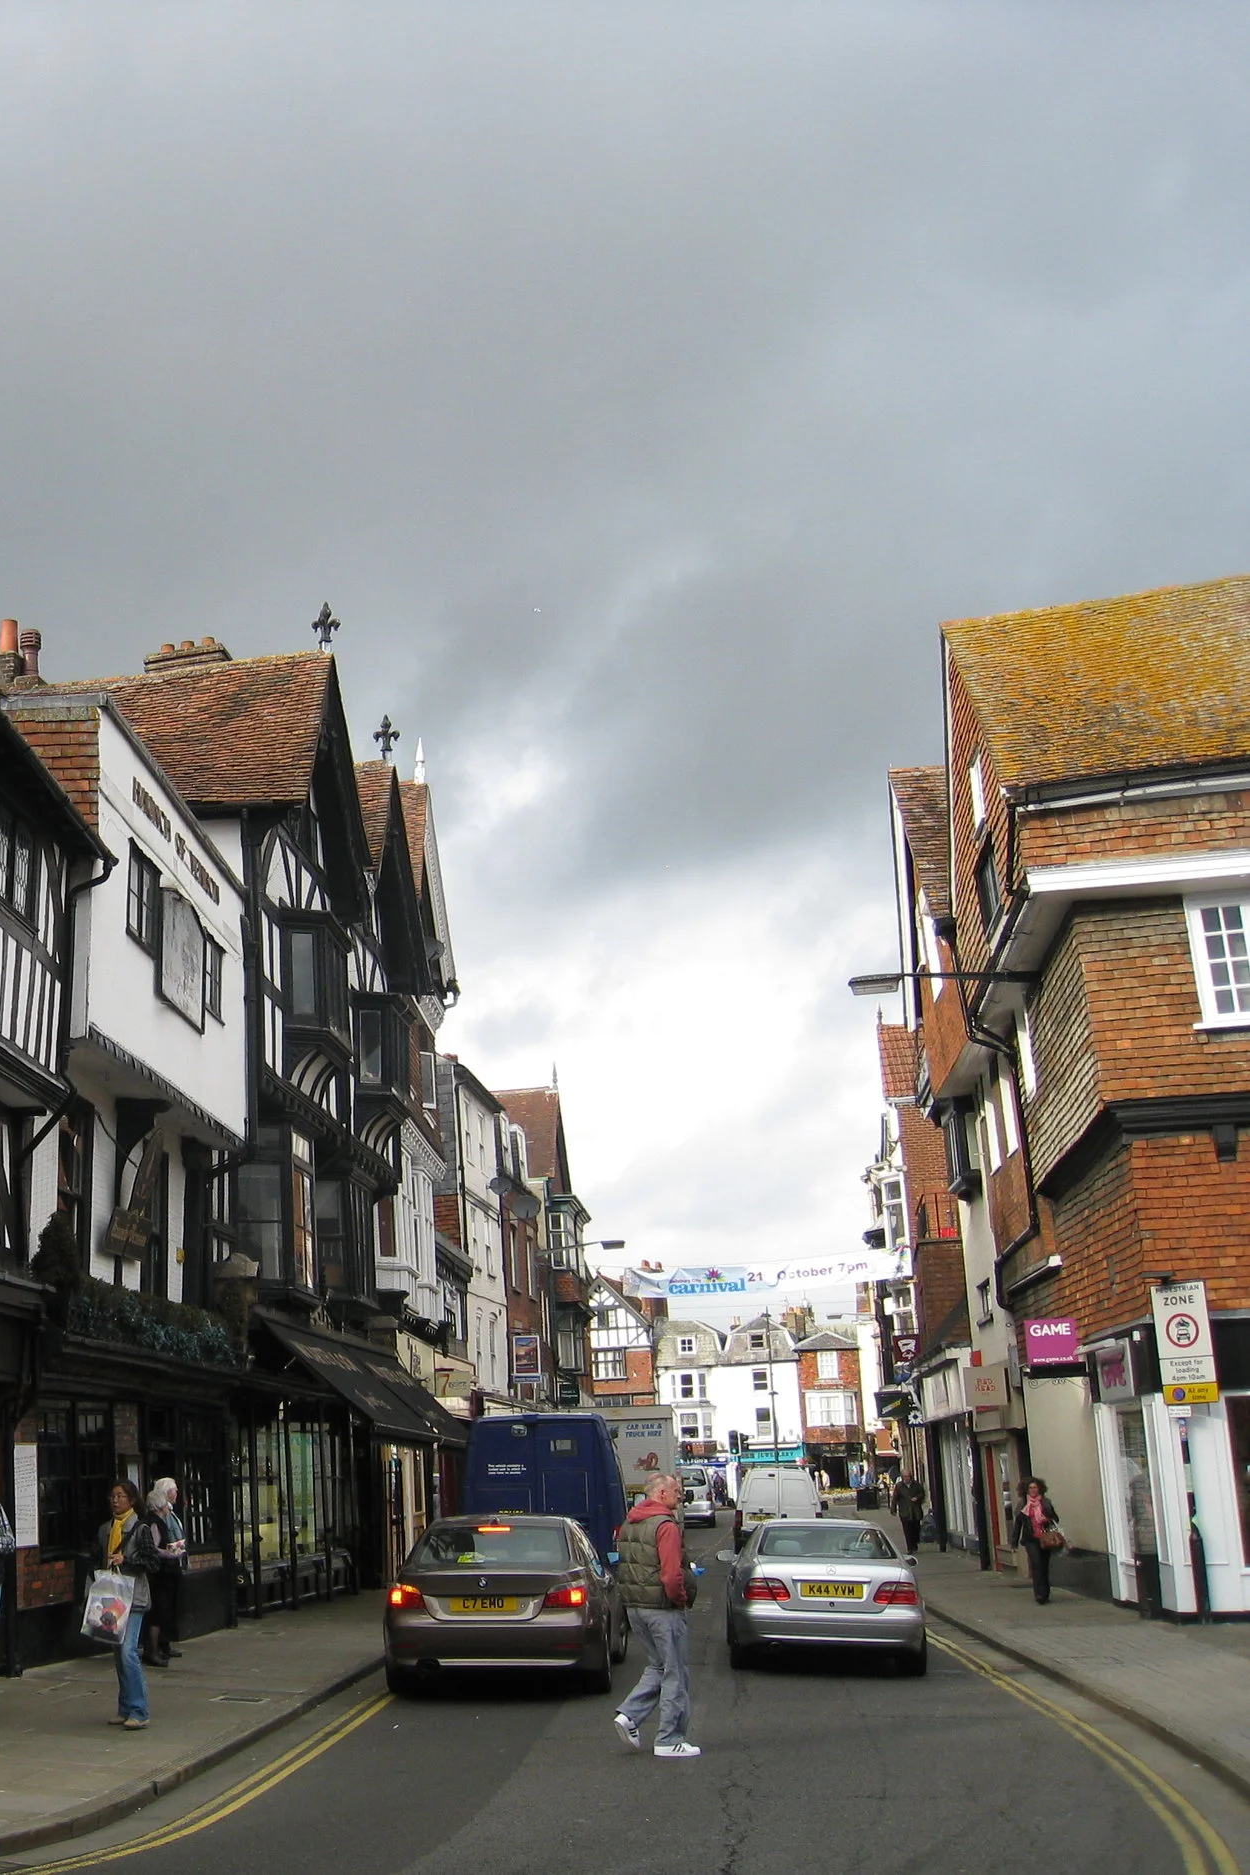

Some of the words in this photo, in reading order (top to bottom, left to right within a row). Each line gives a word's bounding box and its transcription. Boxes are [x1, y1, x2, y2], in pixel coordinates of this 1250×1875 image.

[748, 1272, 763, 1282] 21
[777, 1267, 833, 1280] October
[838, 1262, 868, 1274] 7pm
[669, 1278, 747, 1294] carnival
[1163, 1295, 1195, 1306] ZONE
[1030, 1323, 1071, 1337] GAME
[809, 1585, 830, 1595] K44
[833, 1585, 855, 1595] YVM
[463, 1598, 477, 1609] C7
